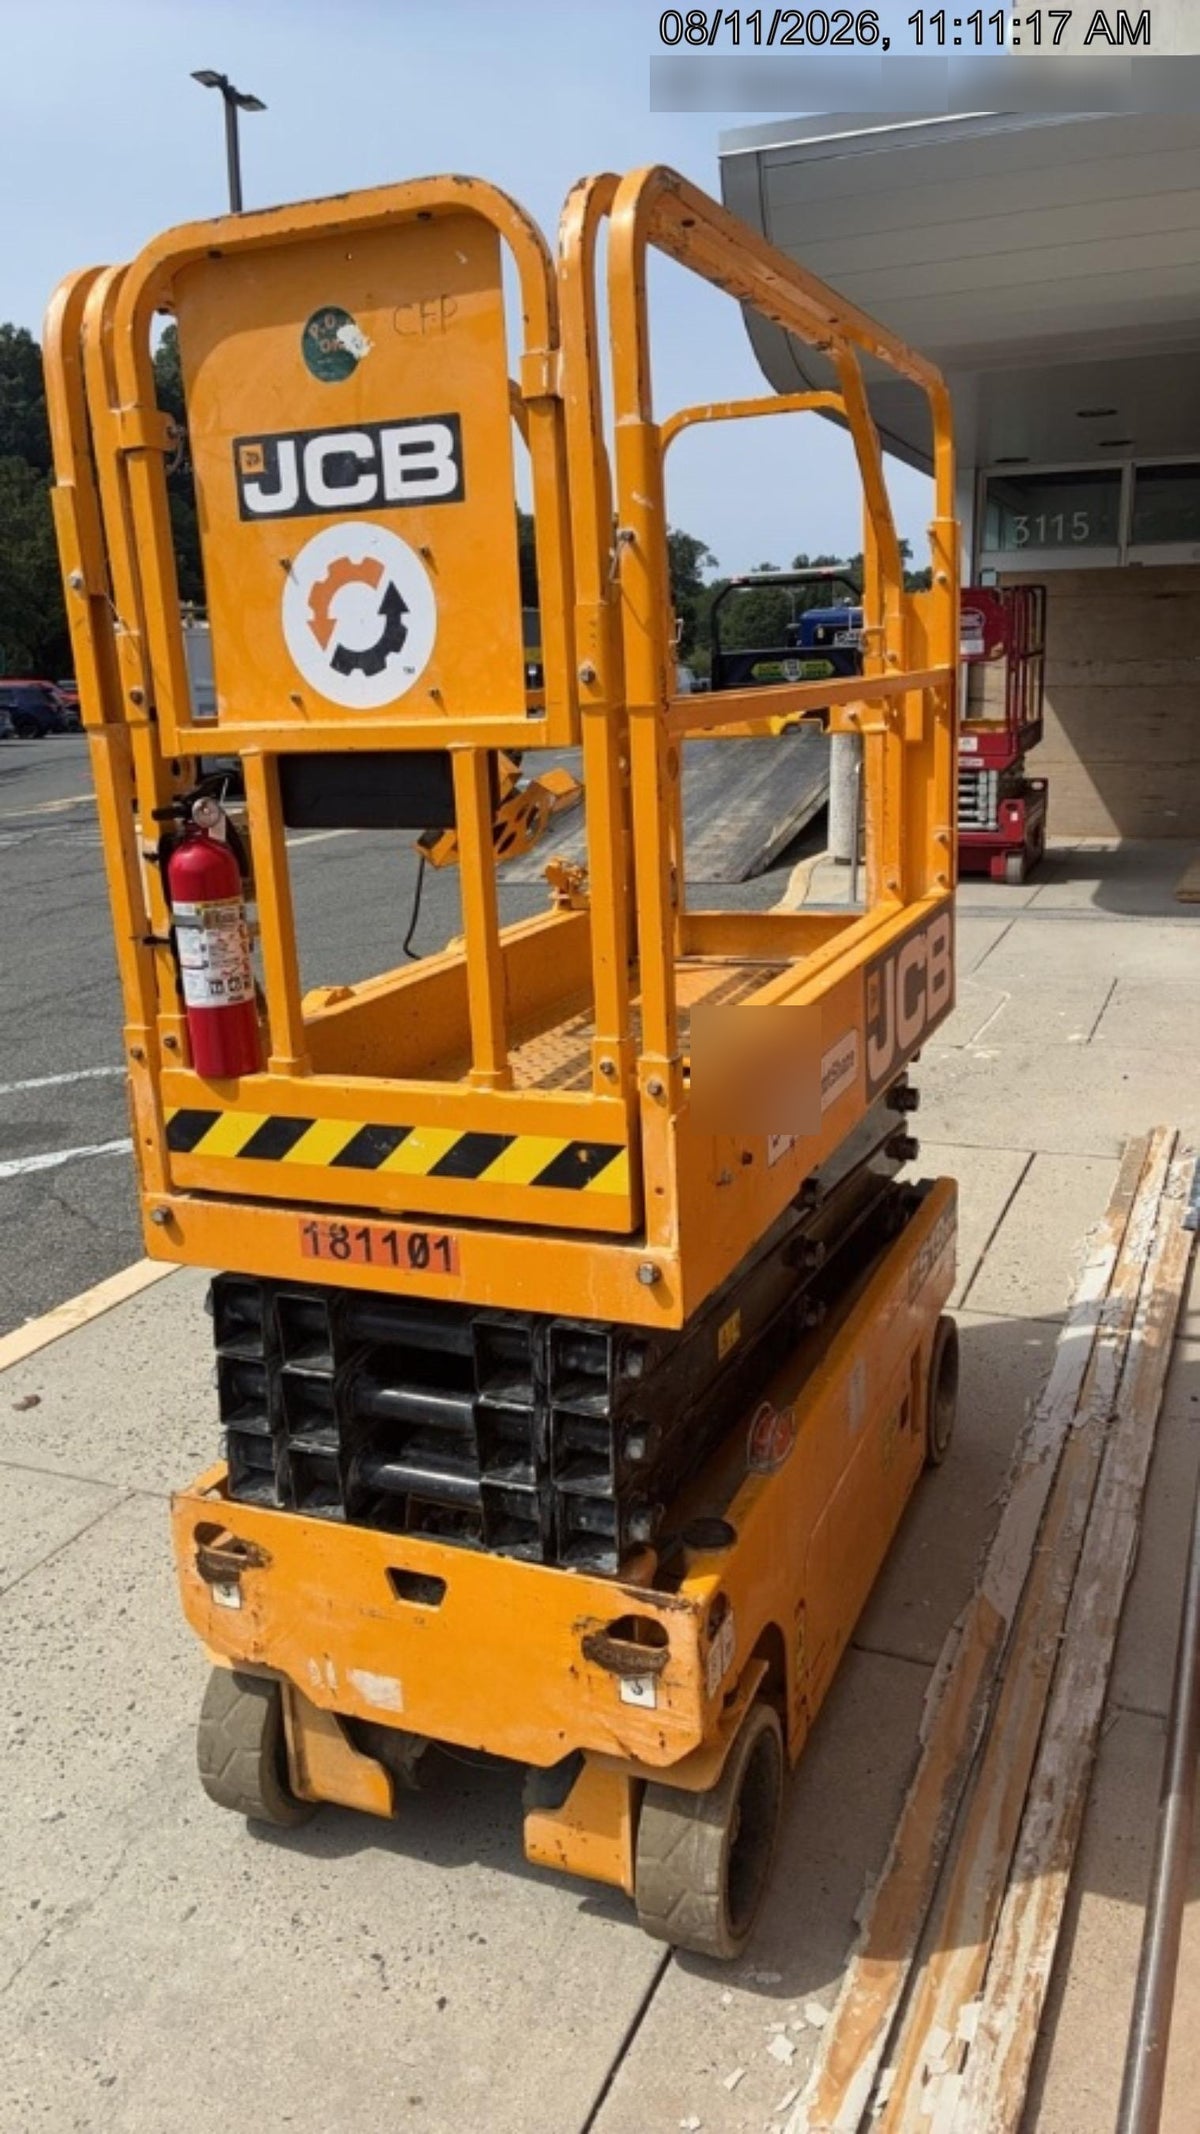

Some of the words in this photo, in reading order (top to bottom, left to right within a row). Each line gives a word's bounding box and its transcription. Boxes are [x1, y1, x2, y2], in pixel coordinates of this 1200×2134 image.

[243, 423, 459, 514] JCB
[1013, 512, 1089, 544] 3115
[867, 912, 951, 1083] JCB
[303, 1221, 452, 1272] 181101
